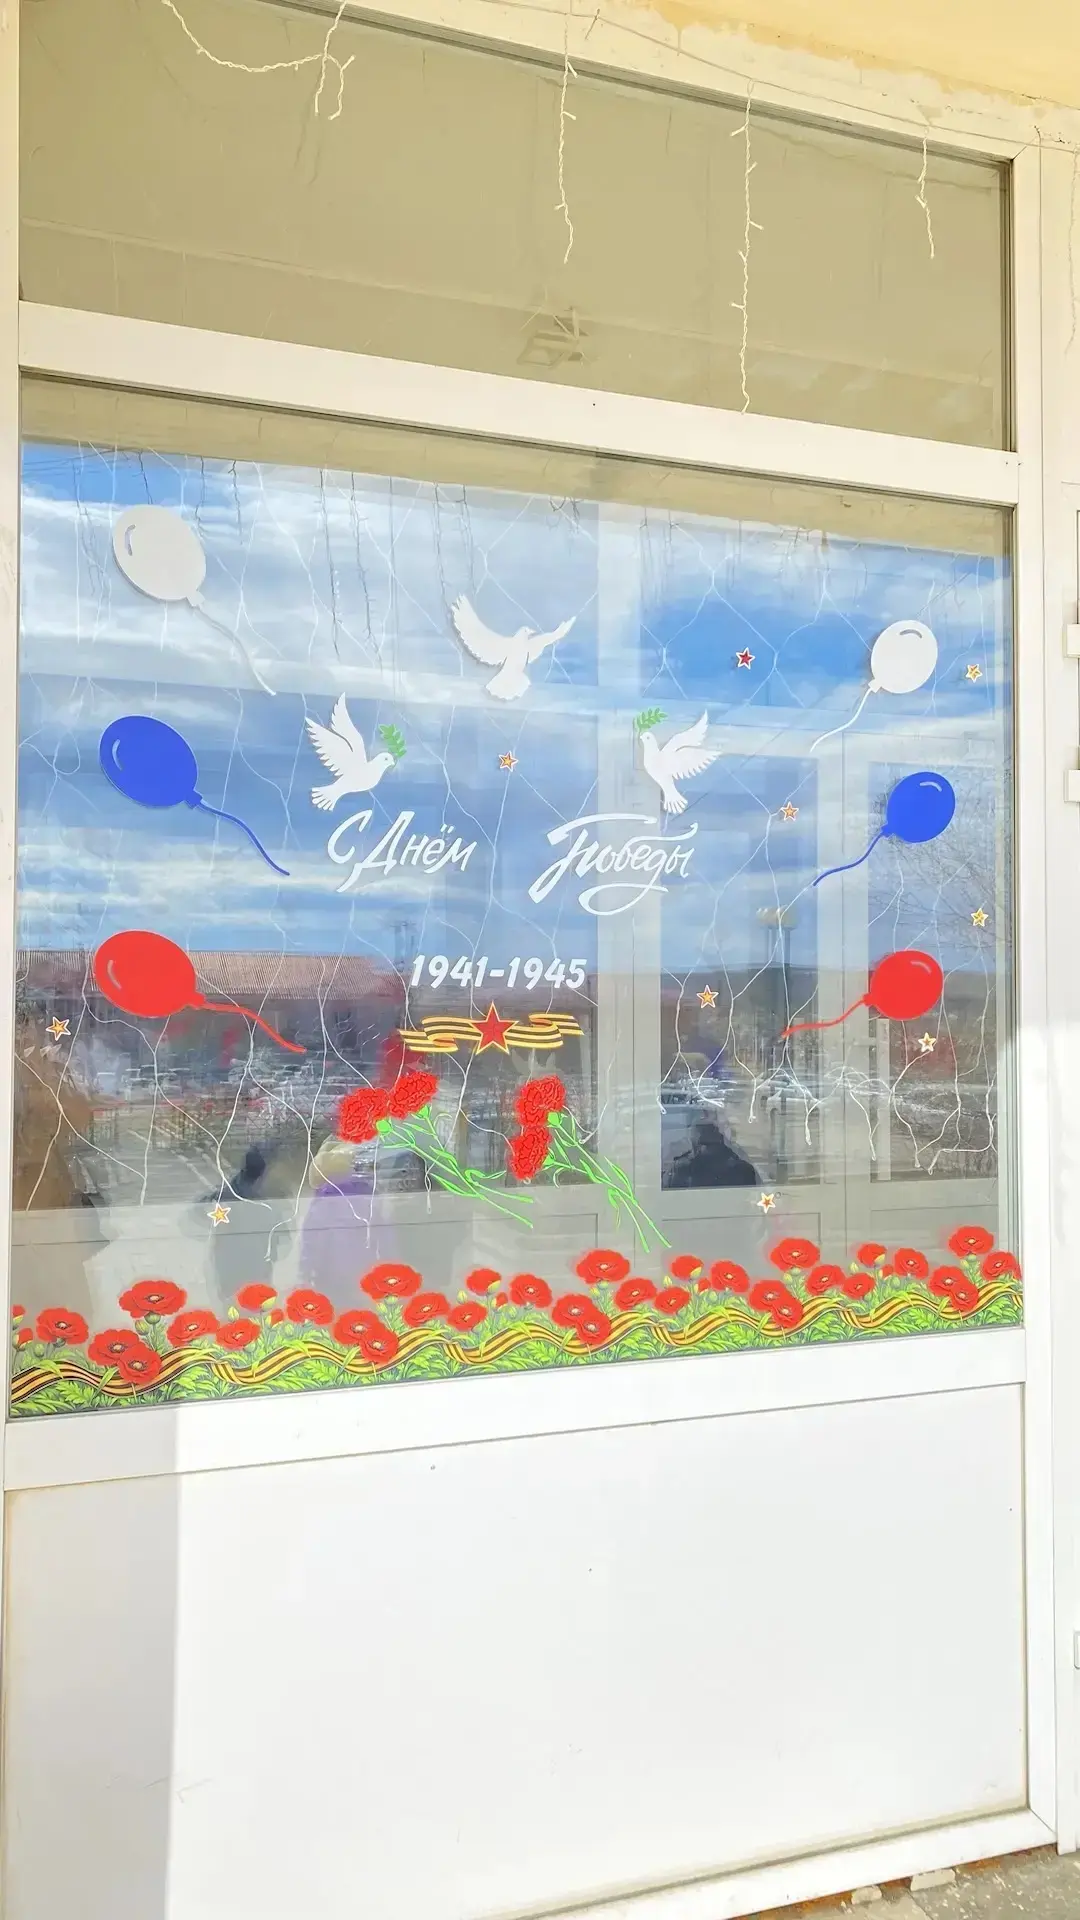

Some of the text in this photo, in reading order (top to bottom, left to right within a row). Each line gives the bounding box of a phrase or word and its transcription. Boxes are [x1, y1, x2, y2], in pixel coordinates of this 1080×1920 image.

[327, 810, 698, 915] С Днём Победы
[411, 954, 587, 990] 1941-1945
